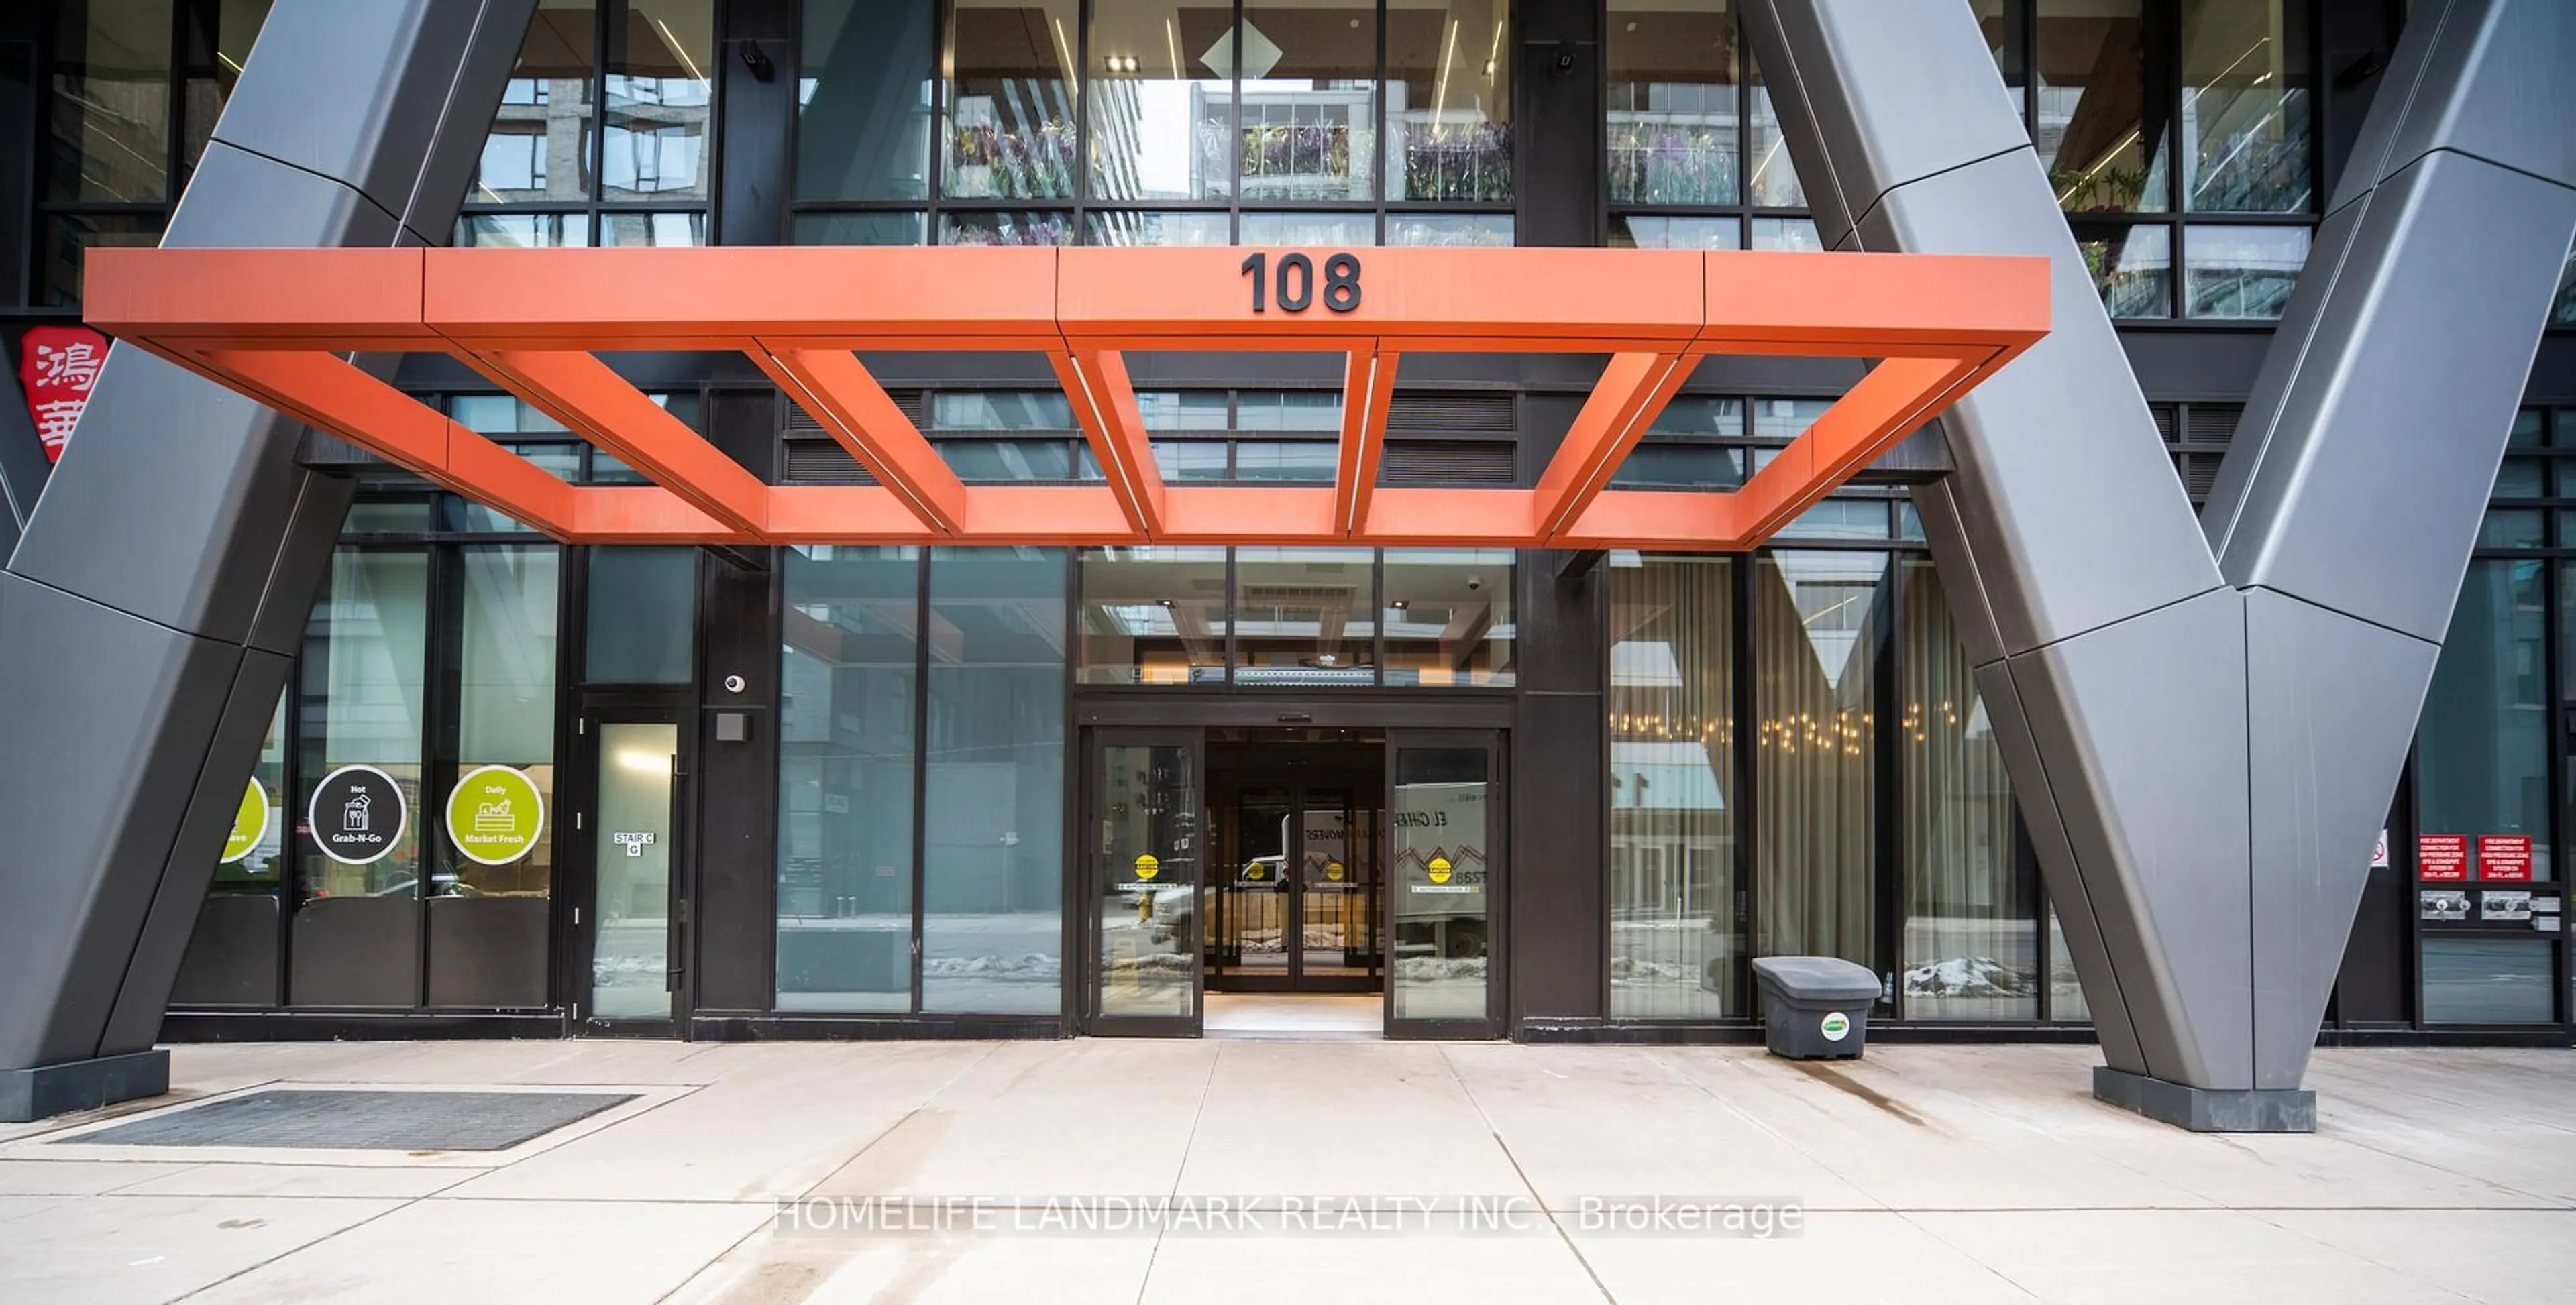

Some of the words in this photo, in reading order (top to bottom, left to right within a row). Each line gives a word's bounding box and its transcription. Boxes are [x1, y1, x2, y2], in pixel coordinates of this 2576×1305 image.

[1241, 252, 1362, 313] 108
[350, 785, 366, 793] Hot
[485, 785, 506, 795] Daily
[332, 834, 382, 842] Grab-N-Go
[464, 834, 498, 843] Market
[498, 834, 524, 843] Fresh
[616, 834, 644, 842] STAIR
[646, 834, 653, 842] C
[629, 845, 638, 854] G
